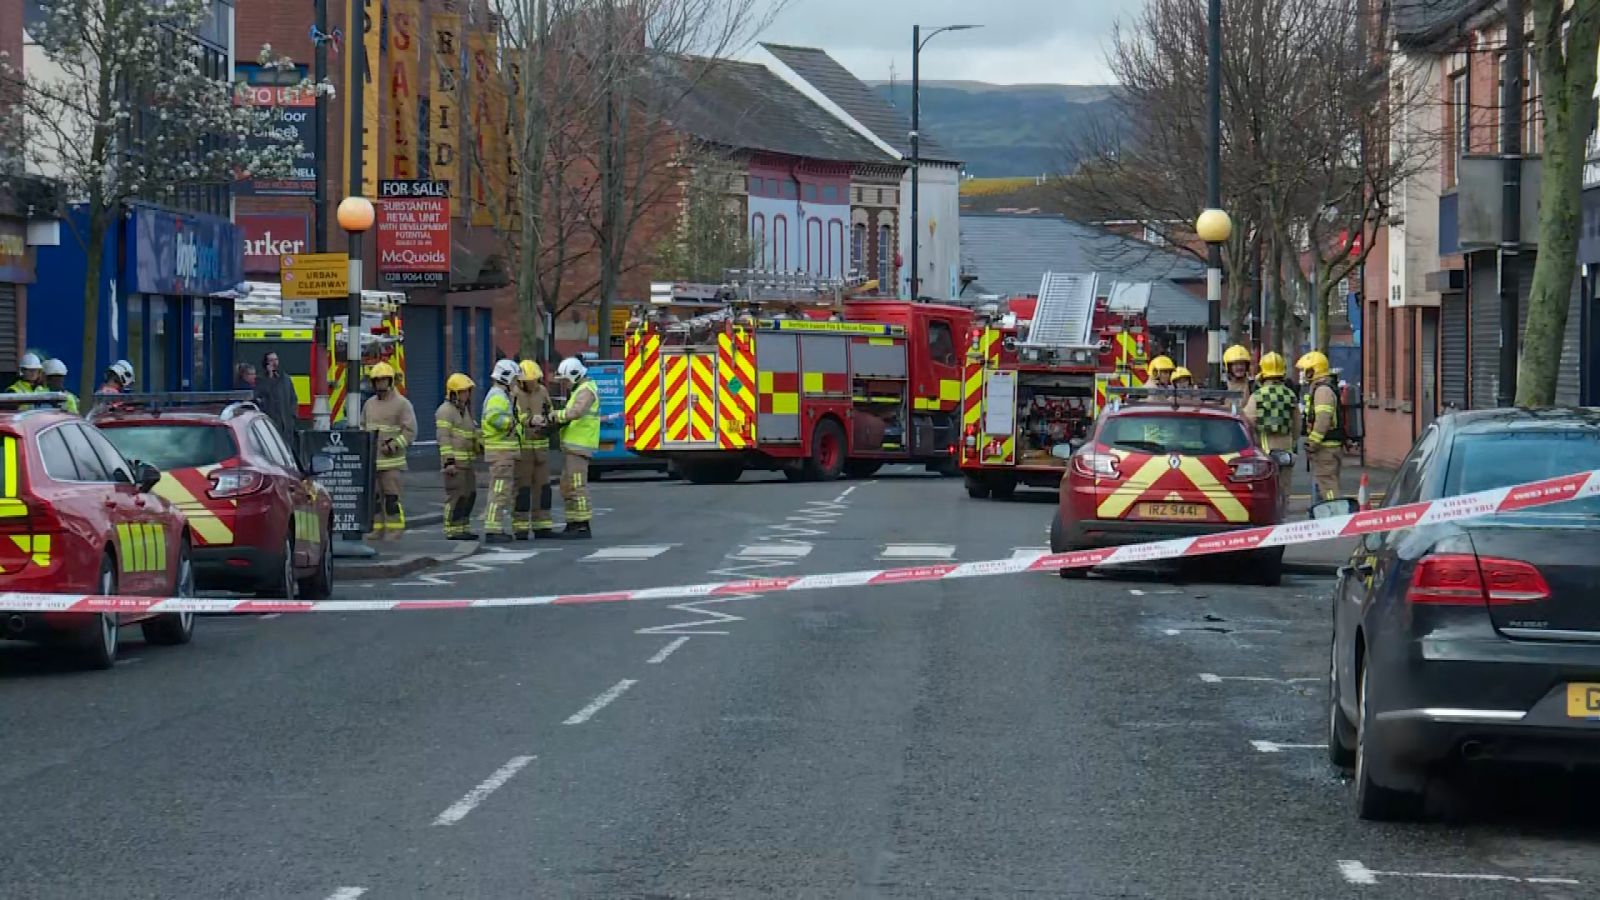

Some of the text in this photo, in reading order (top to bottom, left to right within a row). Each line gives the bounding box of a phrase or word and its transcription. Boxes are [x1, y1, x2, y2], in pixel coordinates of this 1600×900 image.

[383, 182, 443, 196] FOR SALE
[383, 201, 442, 211] SUBSTANTIAL
[386, 213, 441, 222] RETAIL UNIT
[379, 223, 448, 231] WITH DEVELOPMENT
[395, 231, 431, 239] POTENTIAL
[243, 230, 304, 256] arker
[382, 249, 446, 264] McQuoids
[306, 271, 338, 280] URBAN
[298, 281, 347, 290] CLEARWAY
[1148, 504, 1197, 516] IRZ 9441
